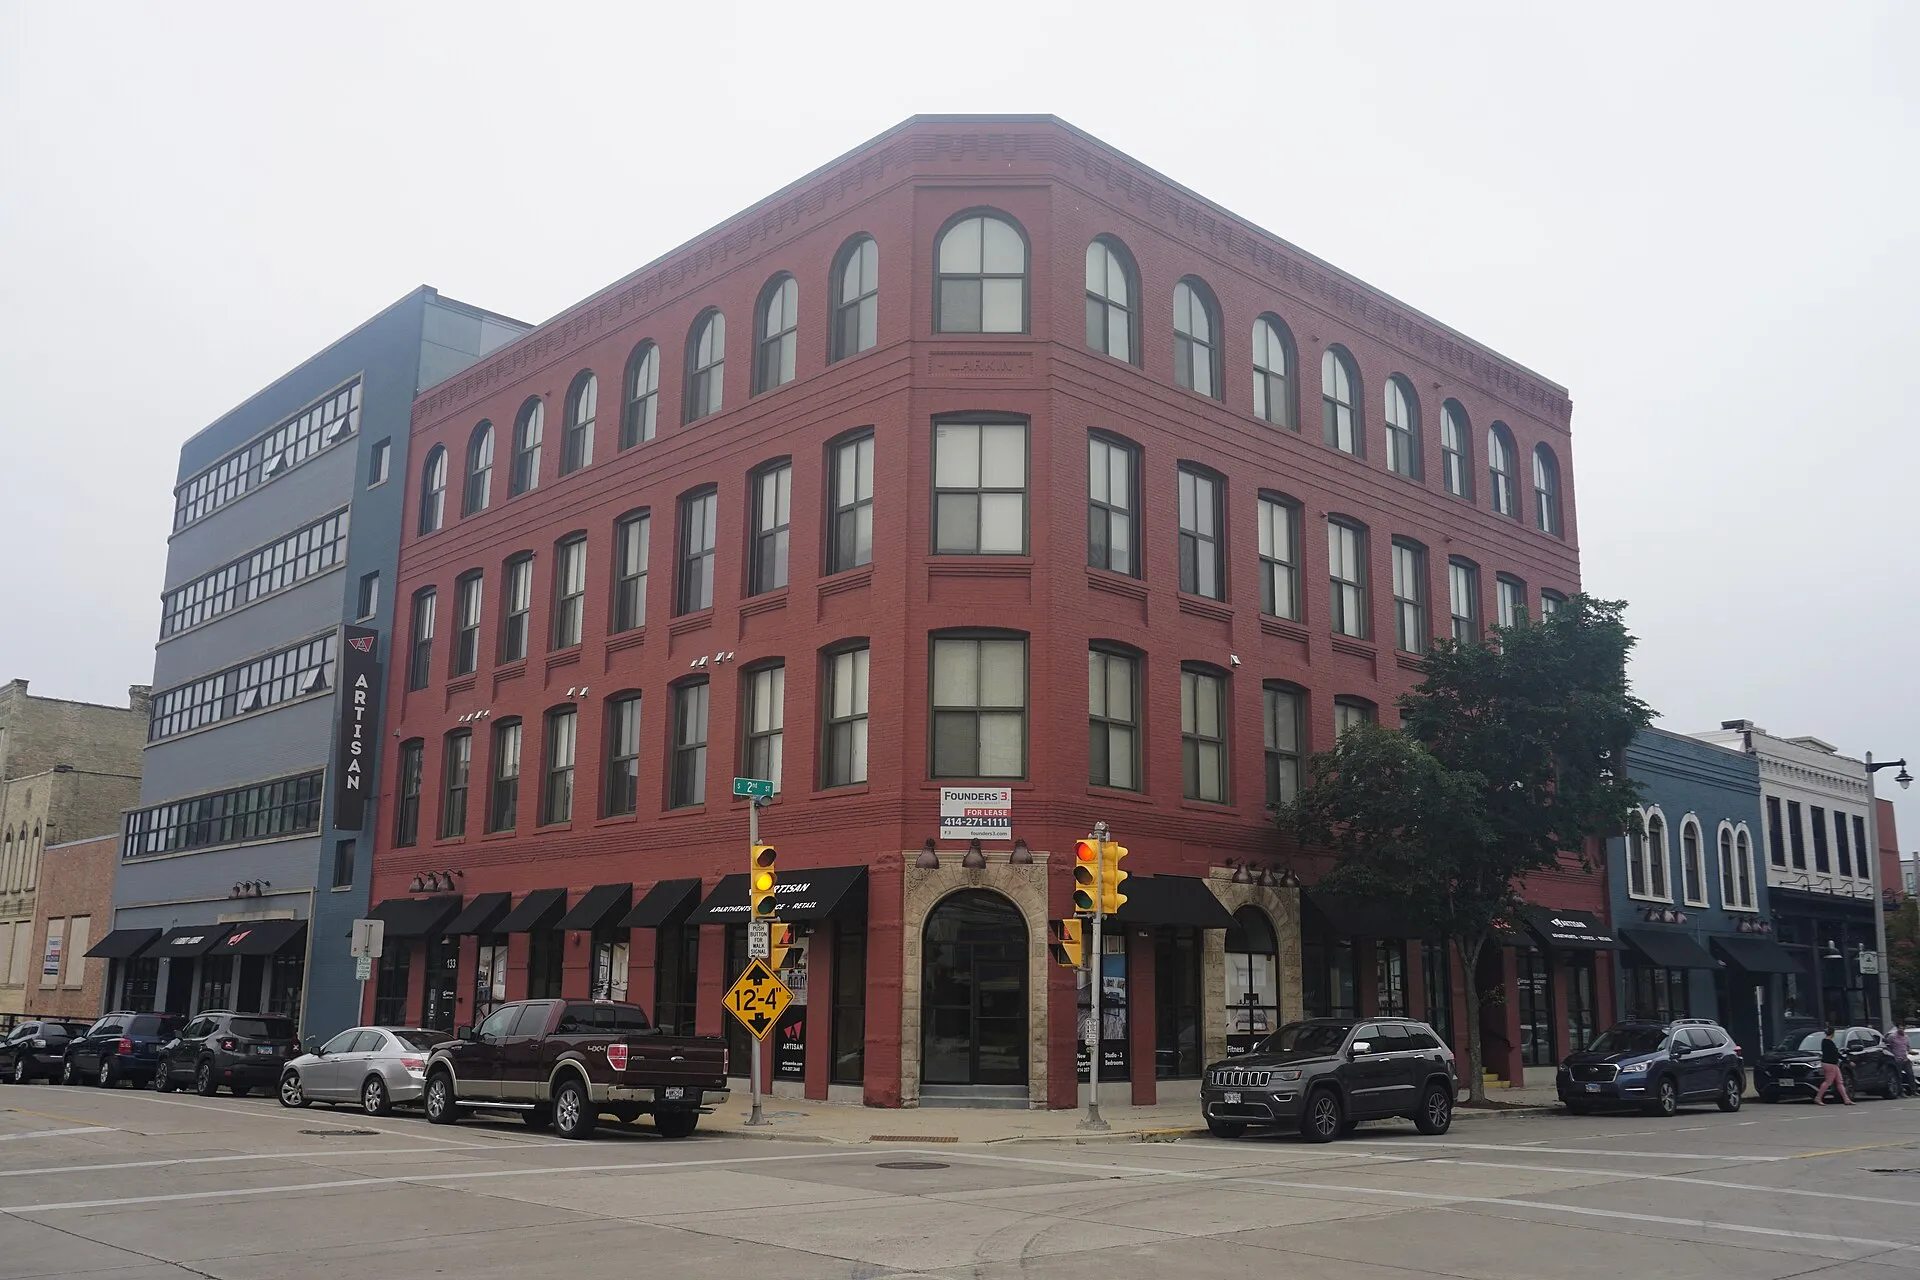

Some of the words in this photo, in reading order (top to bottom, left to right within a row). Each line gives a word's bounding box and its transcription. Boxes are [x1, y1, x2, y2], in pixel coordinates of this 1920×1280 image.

[346, 673, 369, 790] ARTISAN
[747, 781, 758, 793] 2nd
[944, 791, 998, 801] FOUNDERS
[1000, 791, 1008, 801] 3
[944, 817, 1008, 827] 414-271-1111
[709, 905, 752, 913] APARTMENTS
[792, 901, 817, 909] RETAIL
[446, 958, 457, 969] 133
[1227, 1045, 1245, 1053] Fitness
